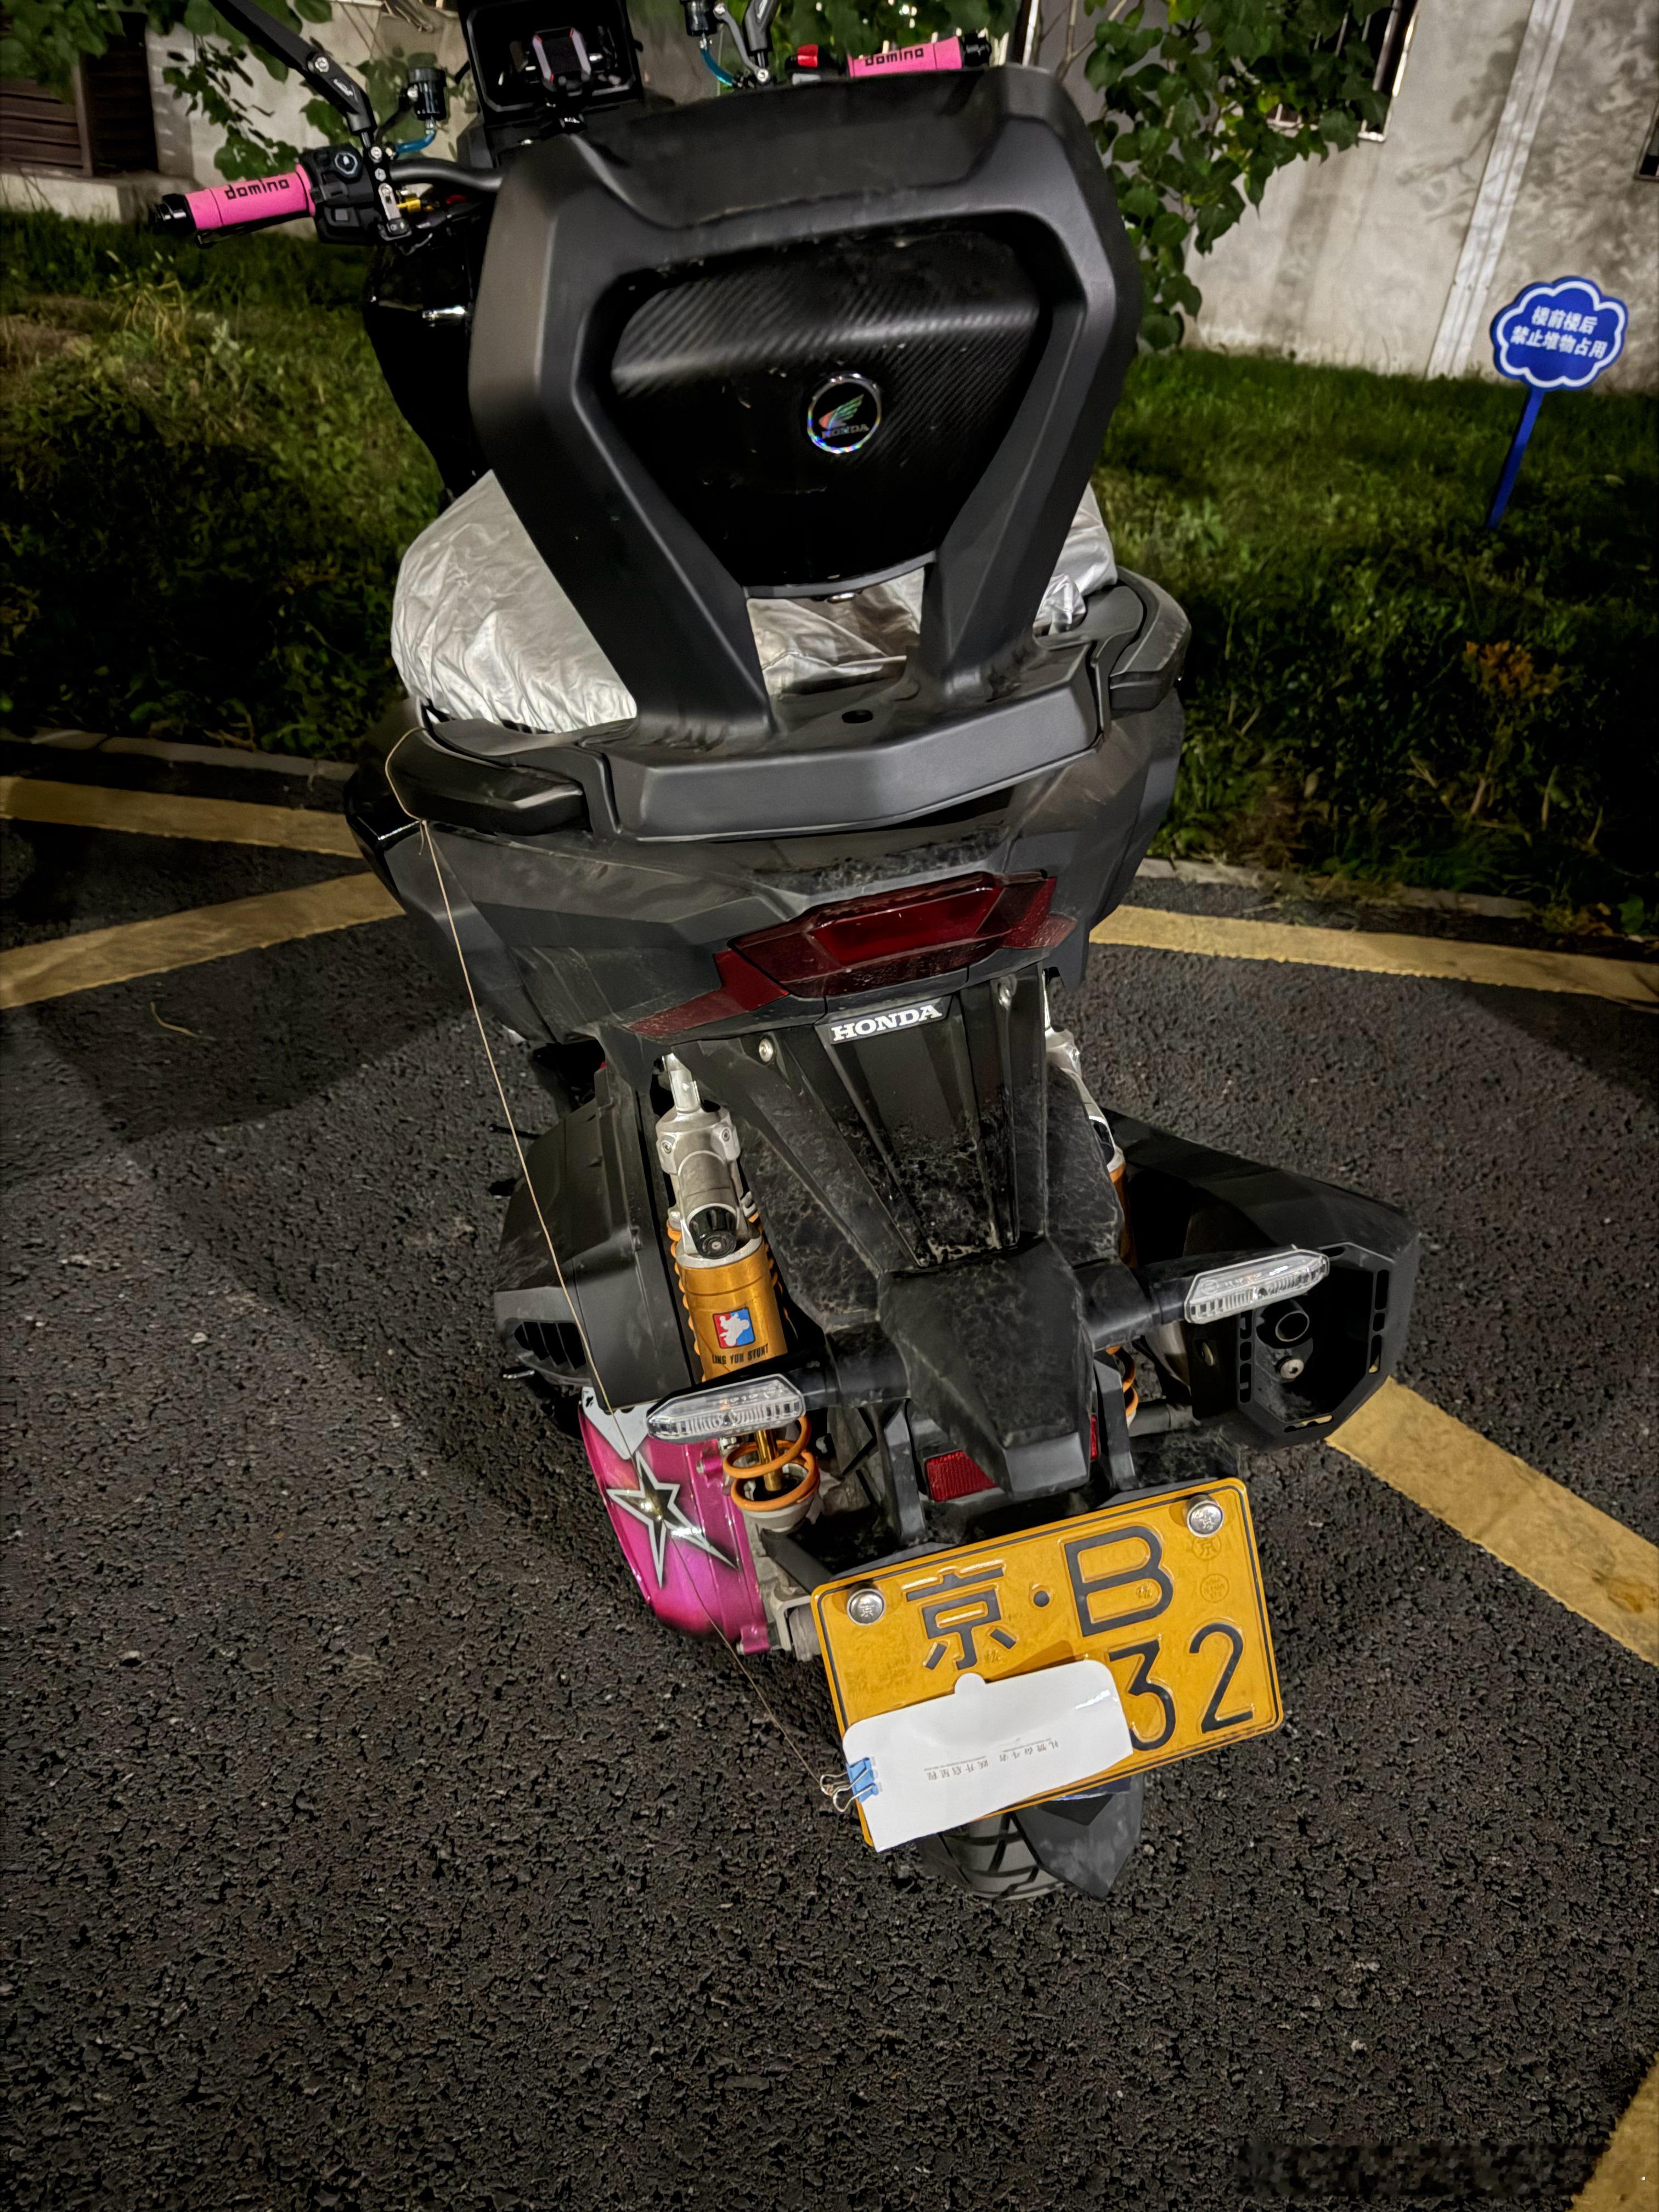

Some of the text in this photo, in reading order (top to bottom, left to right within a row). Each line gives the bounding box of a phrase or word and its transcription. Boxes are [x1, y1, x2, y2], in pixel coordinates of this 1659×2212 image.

[865, 47, 924, 66] domino
[224, 178, 290, 200] domino
[1531, 305, 1598, 335] 楼前楼后
[1510, 325, 1608, 359] 禁止堆物占用
[821, 424, 870, 439] HONDA
[831, 1005, 943, 1041] HONDA
[748, 1343, 769, 1361] STUNT
